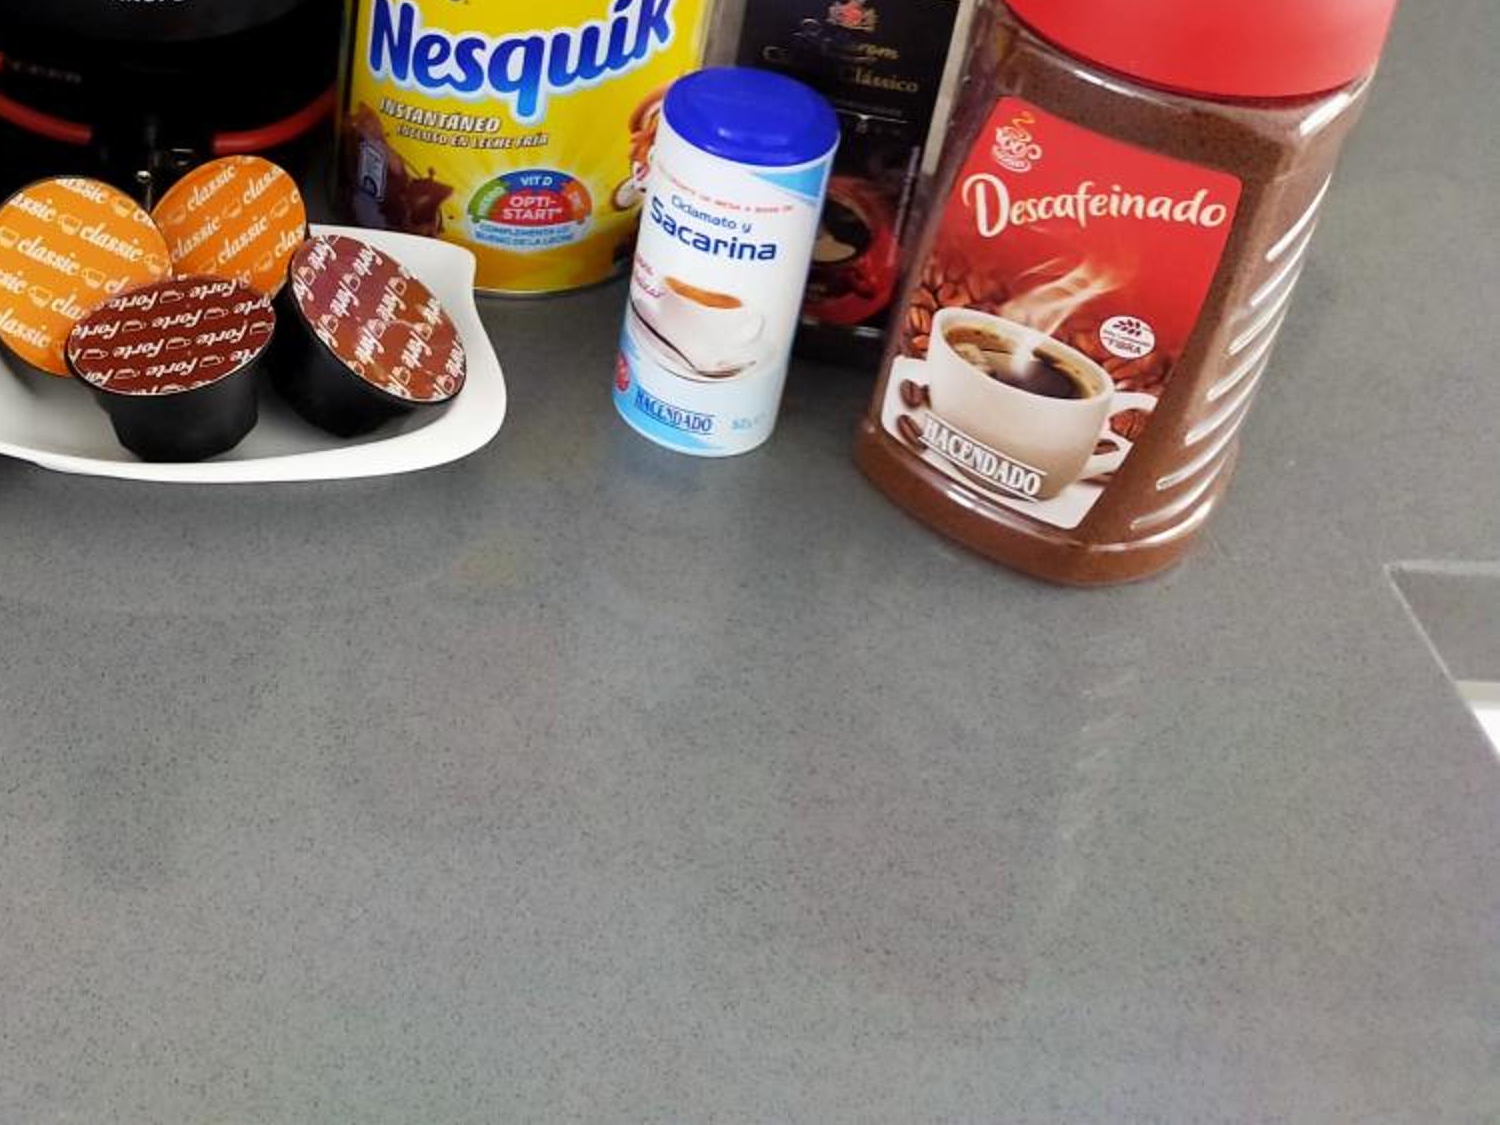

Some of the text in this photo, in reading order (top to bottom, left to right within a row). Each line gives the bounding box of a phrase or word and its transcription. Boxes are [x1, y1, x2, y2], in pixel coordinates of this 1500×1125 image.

[379, 97, 503, 133] INSTANTÁNEO
[187, 164, 237, 212] classic
[520, 176, 553, 186] VIT D
[509, 195, 557, 208] OPTI-
[962, 172, 1228, 238] Descafeinado
[79, 221, 145, 263] classic
[171, 215, 221, 263] classic
[217, 215, 269, 265] classic
[650, 195, 778, 261] Sacarina
[741, 222, 752, 234] y
[16, 236, 82, 279] classic
[109, 290, 159, 312] forte
[189, 278, 237, 299] forte
[375, 284, 407, 321] forte
[72, 320, 121, 340] forte
[151, 308, 203, 329] forte
[113, 323, 247, 359] forte forte
[401, 328, 433, 370] forte
[145, 357, 198, 378] forte
[635, 388, 713, 432] HACENDADO
[923, 416, 1042, 498] HACENDADO
